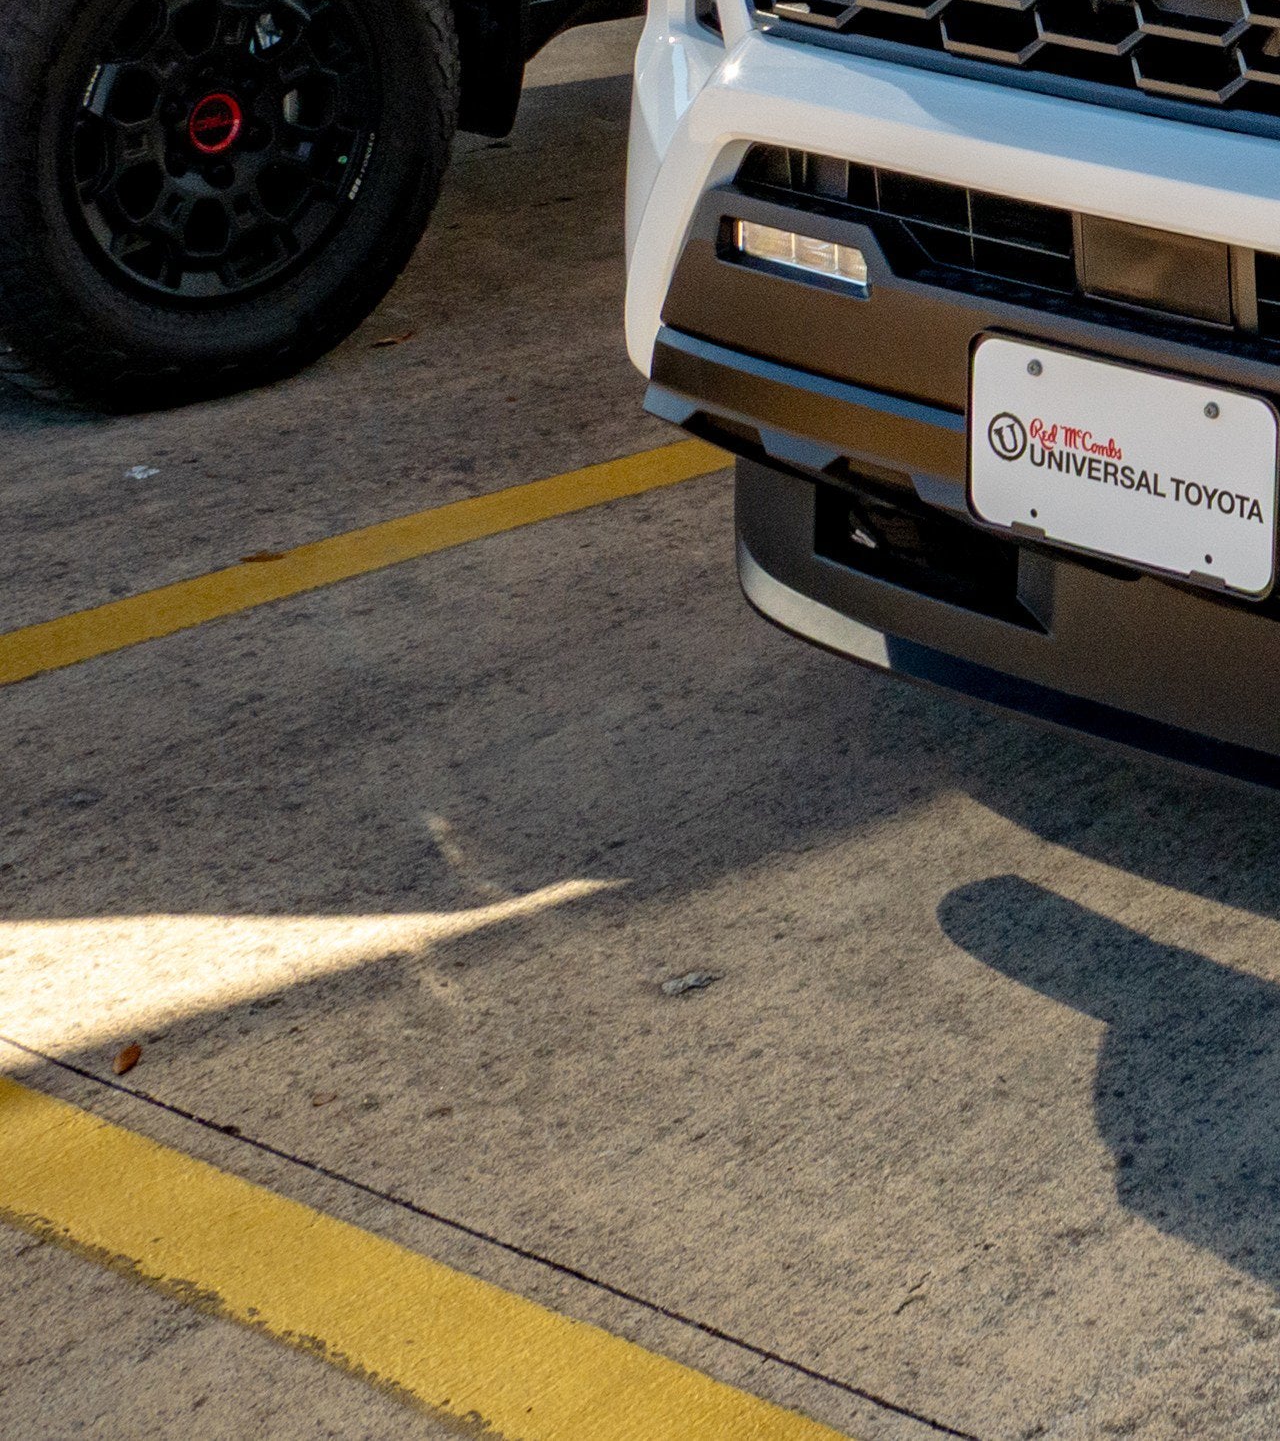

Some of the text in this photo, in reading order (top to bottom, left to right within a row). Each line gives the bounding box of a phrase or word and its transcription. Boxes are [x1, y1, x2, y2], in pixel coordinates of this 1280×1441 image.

[1029, 418, 1123, 461] Red McCombs
[1030, 443, 1265, 524] UNIVERSAL TOYOTA
